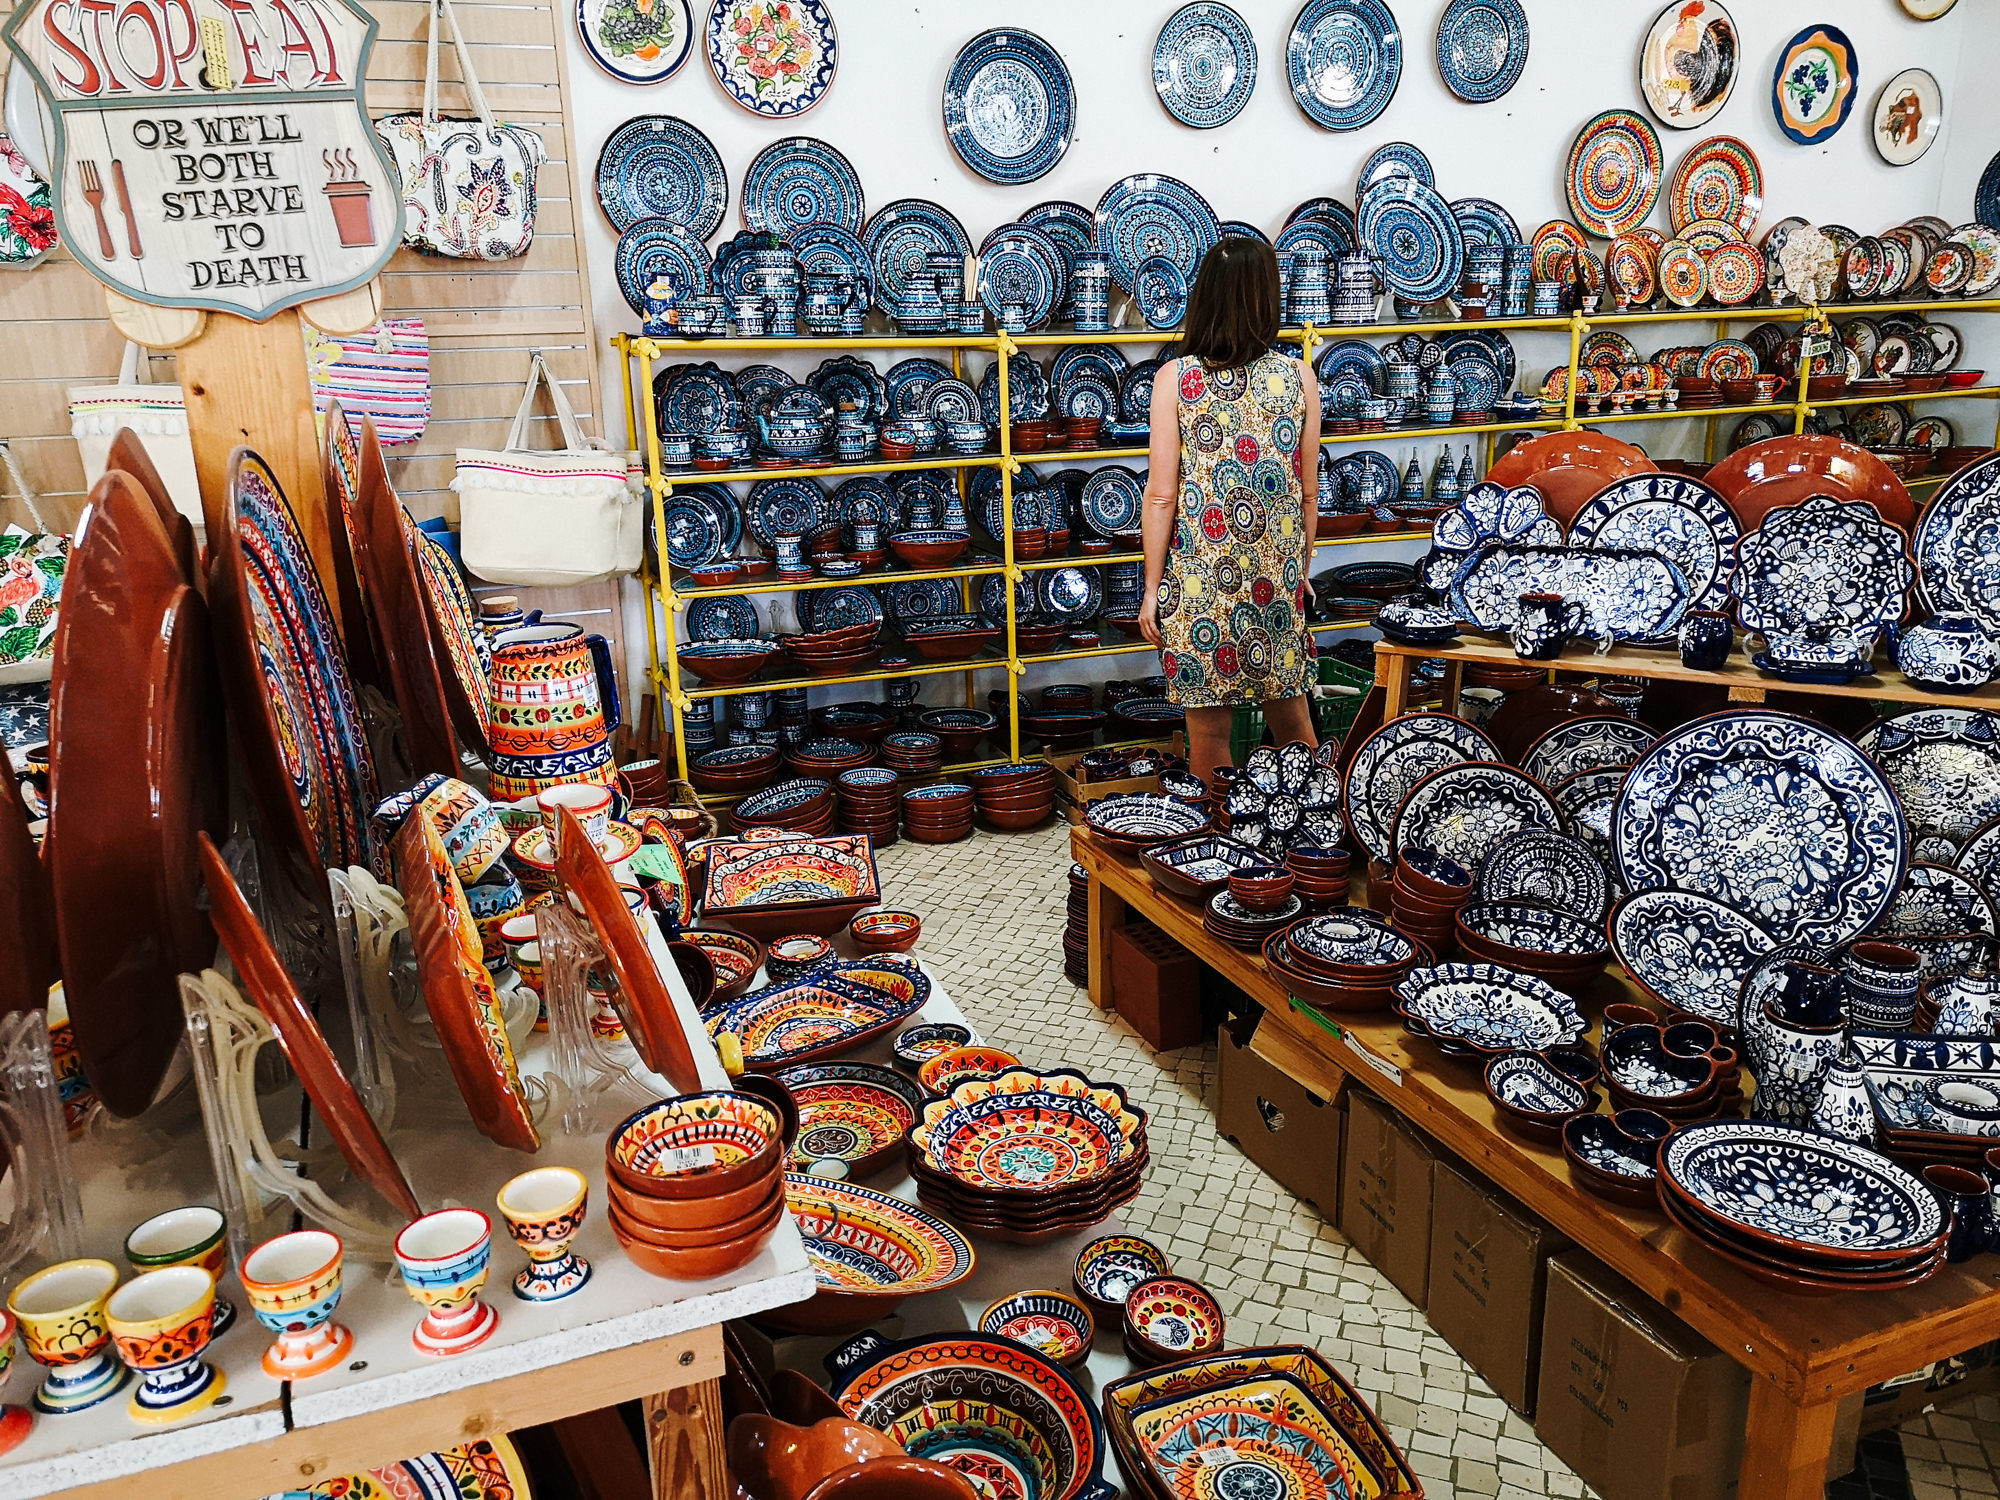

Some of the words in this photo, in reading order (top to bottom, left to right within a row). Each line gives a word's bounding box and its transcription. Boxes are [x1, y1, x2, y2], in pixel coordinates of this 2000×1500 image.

[43, 0, 199, 96] STOP
[133, 119, 188, 149] OR
[193, 114, 302, 146] WE'LL
[172, 151, 278, 183] BOTH
[162, 185, 305, 220] STARVE
[214, 222, 264, 251] TO
[187, 255, 309, 288] DEATH
